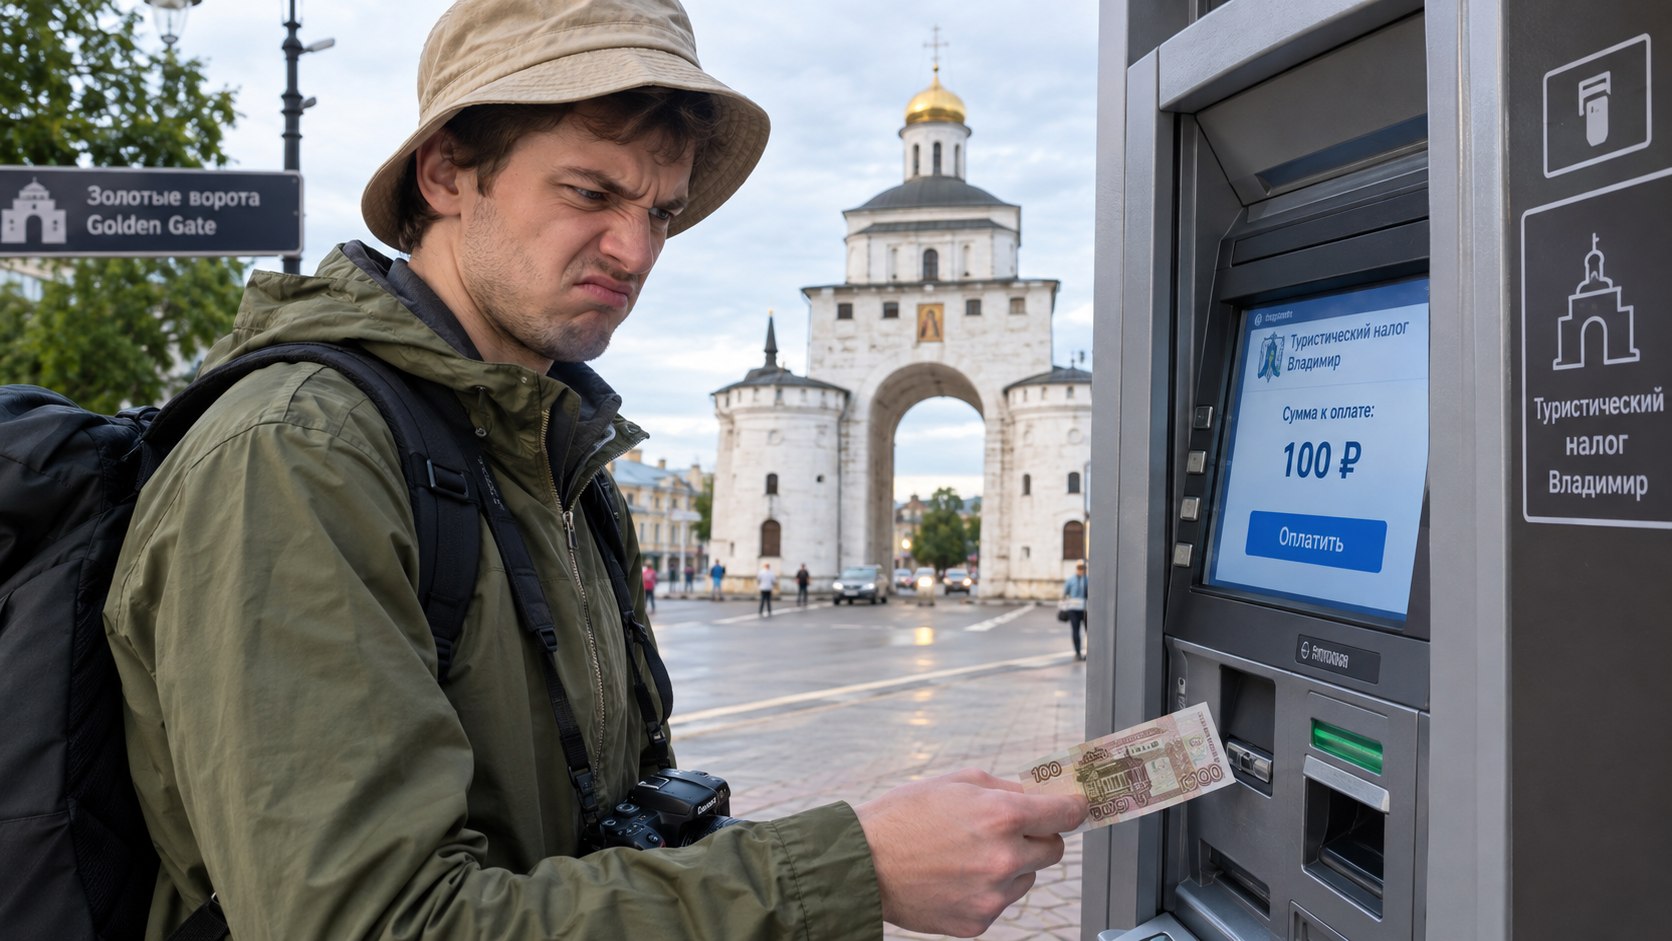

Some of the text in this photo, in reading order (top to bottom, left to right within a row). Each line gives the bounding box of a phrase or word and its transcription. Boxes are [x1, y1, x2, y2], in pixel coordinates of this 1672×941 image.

[87, 185, 260, 210] Золотые ворота
[87, 214, 217, 235] Golden Gate
[1290, 321, 1410, 351] Туристический налог
[1287, 354, 1341, 372] Владимир
[1282, 405, 1375, 424] Сумма к оплате:
[1533, 386, 1664, 425] Туристический
[1566, 434, 1629, 456] налог
[1283, 441, 1332, 479] 100
[1549, 470, 1648, 501] Владимир
[1279, 526, 1344, 553] Оплатить
[1031, 760, 1063, 783] 100
